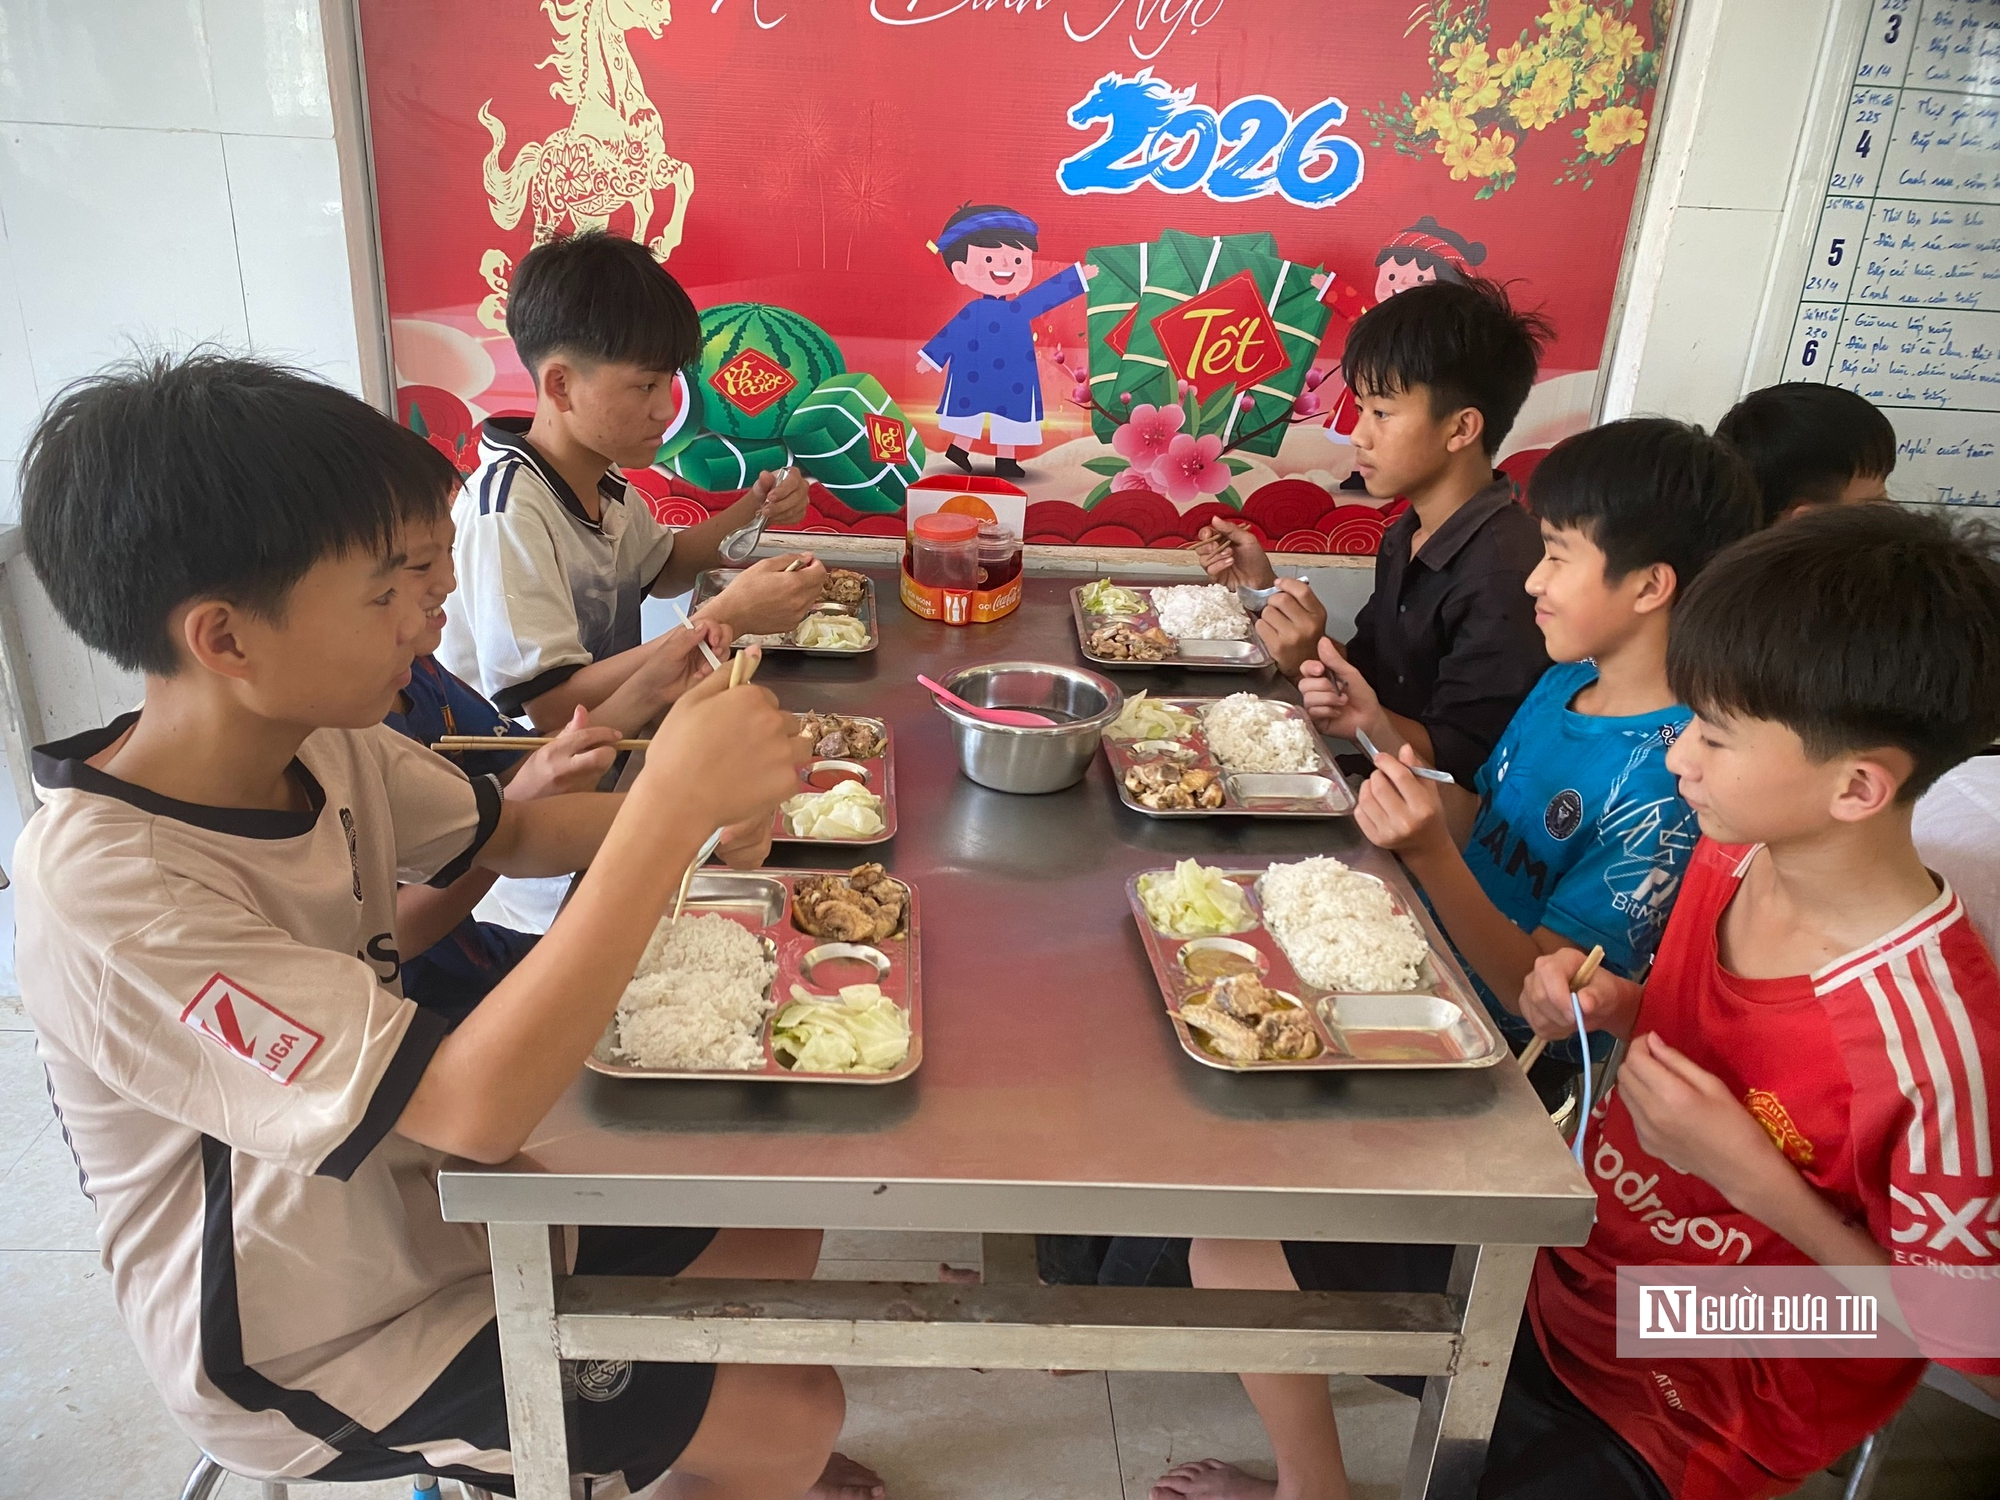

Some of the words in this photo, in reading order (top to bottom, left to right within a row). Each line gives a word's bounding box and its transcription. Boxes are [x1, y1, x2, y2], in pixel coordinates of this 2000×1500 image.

[1884, 14, 1902, 44] 3
[1856, 110, 1882, 124] 225
[1056, 66, 1364, 209] 2026
[1855, 129, 1872, 158] 4
[1831, 173, 1864, 190] 22/4
[1828, 238, 1846, 266] 5
[1182, 308, 1265, 379] Tết
[1802, 339, 1819, 367] 6
[260, 1033, 300, 1072] LIGA
